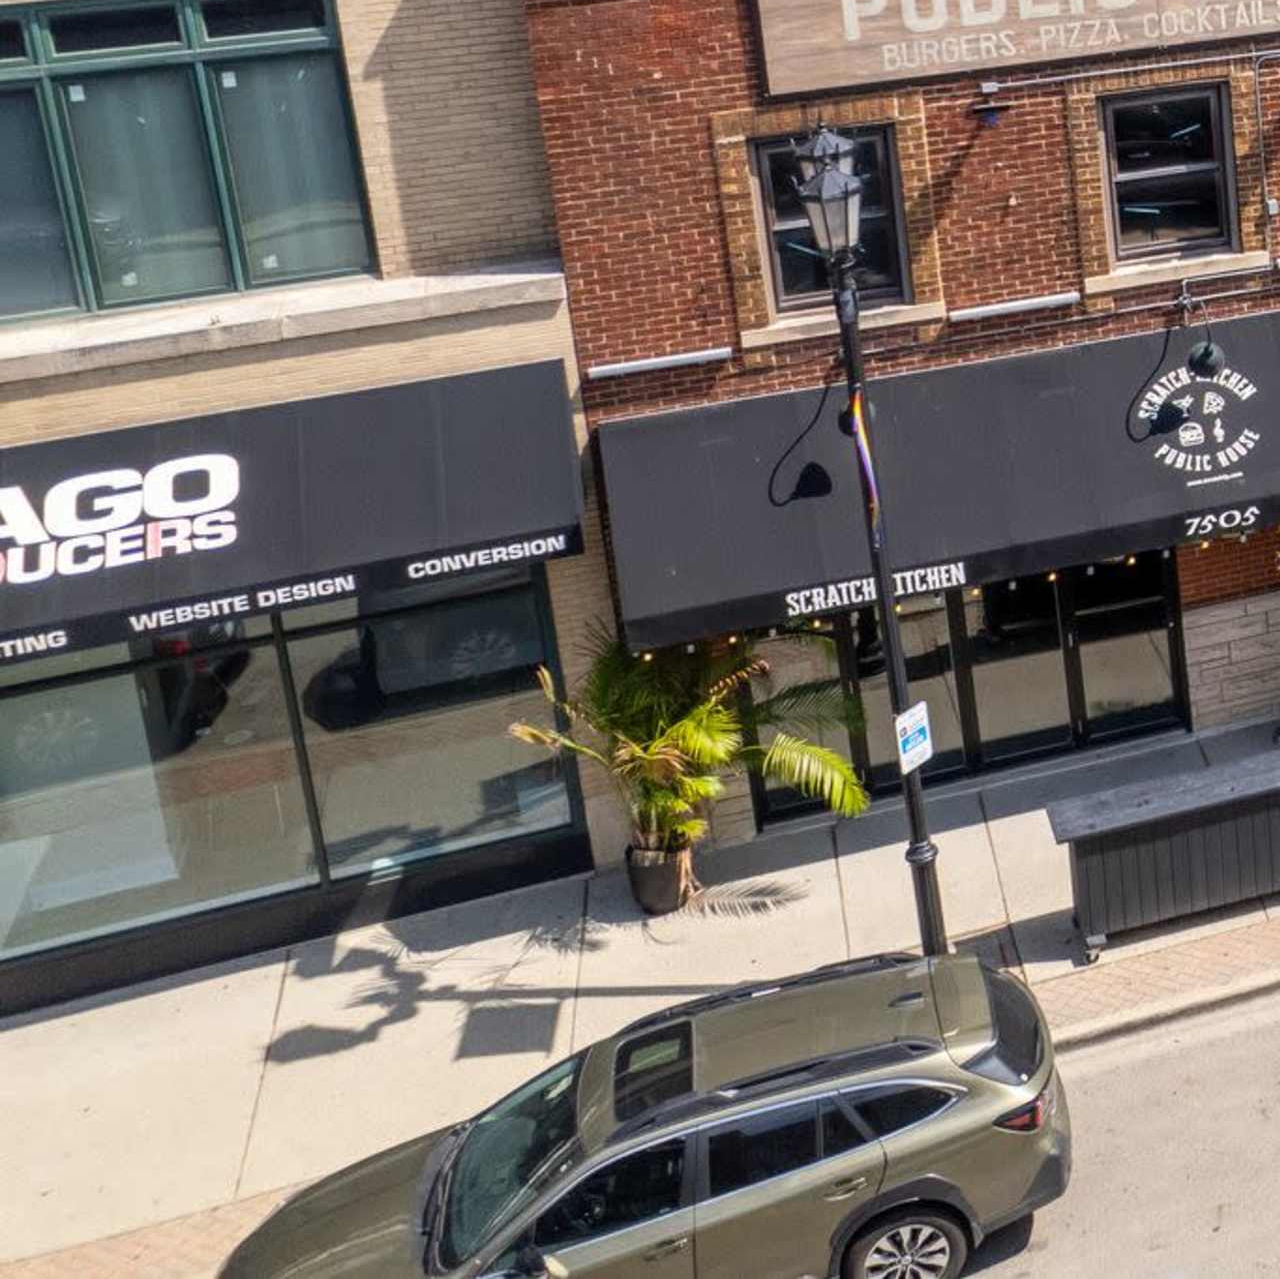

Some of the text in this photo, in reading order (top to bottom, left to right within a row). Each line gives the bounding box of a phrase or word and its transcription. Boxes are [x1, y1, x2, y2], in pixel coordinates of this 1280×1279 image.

[881, 29, 1026, 71] BURGERS.
[1039, 19, 1130, 51] PIZZA.
[1154, 428, 1260, 472] PUBLIC HOUSE
[0, 510, 238, 585] UCERS
[1185, 506, 1261, 536] 7505
[129, 594, 250, 632] WEBSITE
[257, 575, 356, 609] DESIGN
[407, 535, 567, 580] CONVERSION
[785, 562, 966, 616] SCRATCH ITCHEN
